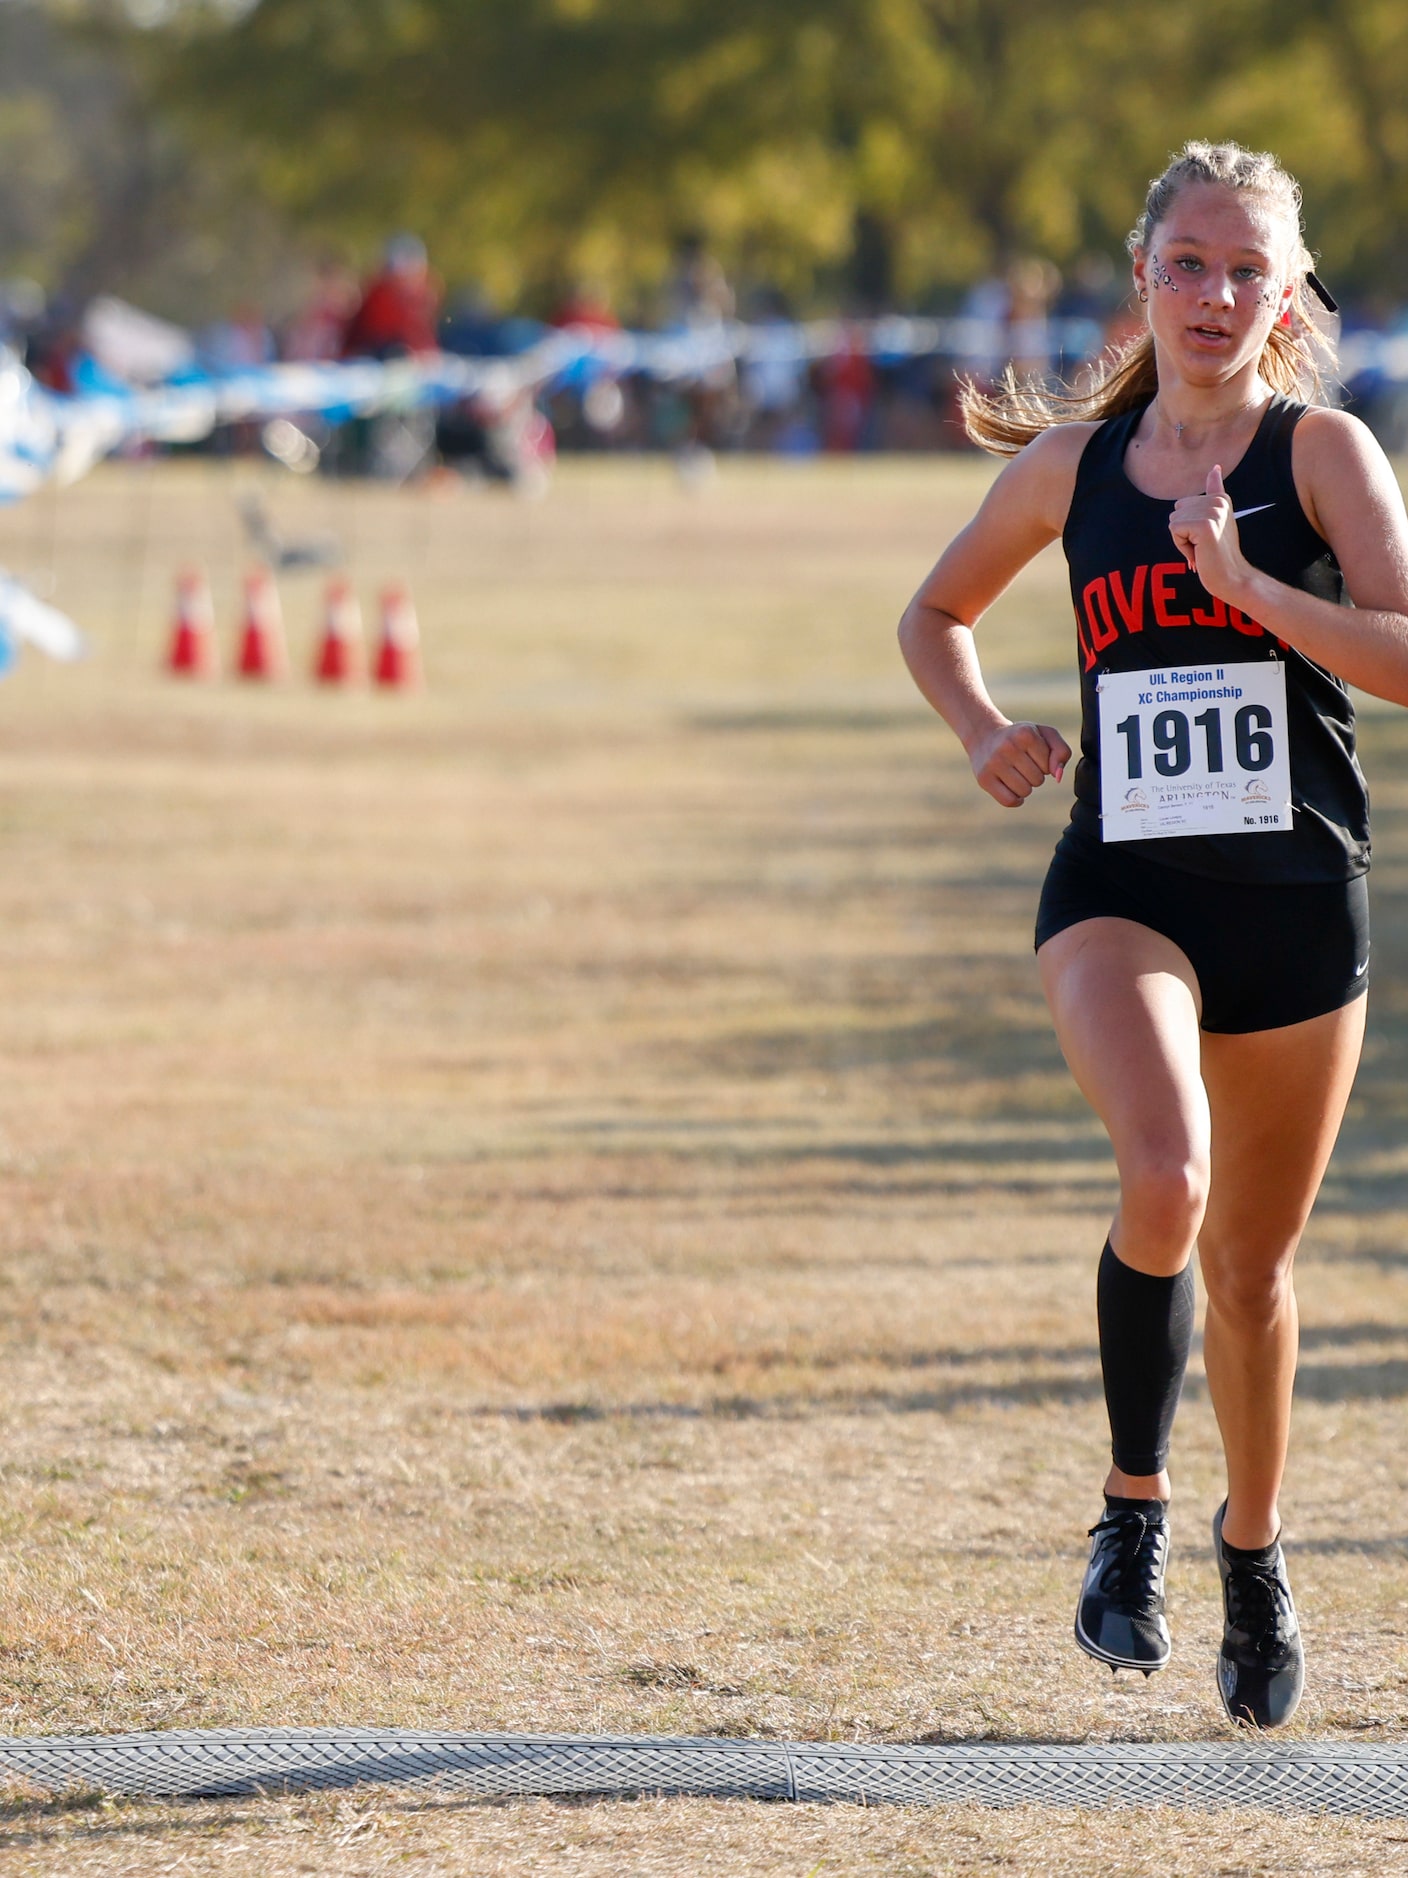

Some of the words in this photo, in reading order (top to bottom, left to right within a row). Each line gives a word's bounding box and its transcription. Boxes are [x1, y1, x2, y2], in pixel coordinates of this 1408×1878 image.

[1075, 562, 1289, 673] LOVEJ
[1149, 673, 1167, 685] UIL
[1171, 670, 1212, 685] Region
[1216, 669, 1224, 680] II
[1138, 692, 1153, 704] XC
[1156, 686, 1242, 702] Championship
[1116, 704, 1274, 780] 1916
[1151, 785, 1164, 793] The
[1166, 783, 1202, 791] University
[1205, 781, 1213, 789] of
[1244, 816, 1256, 824] No.
[1259, 814, 1279, 824] 1916
